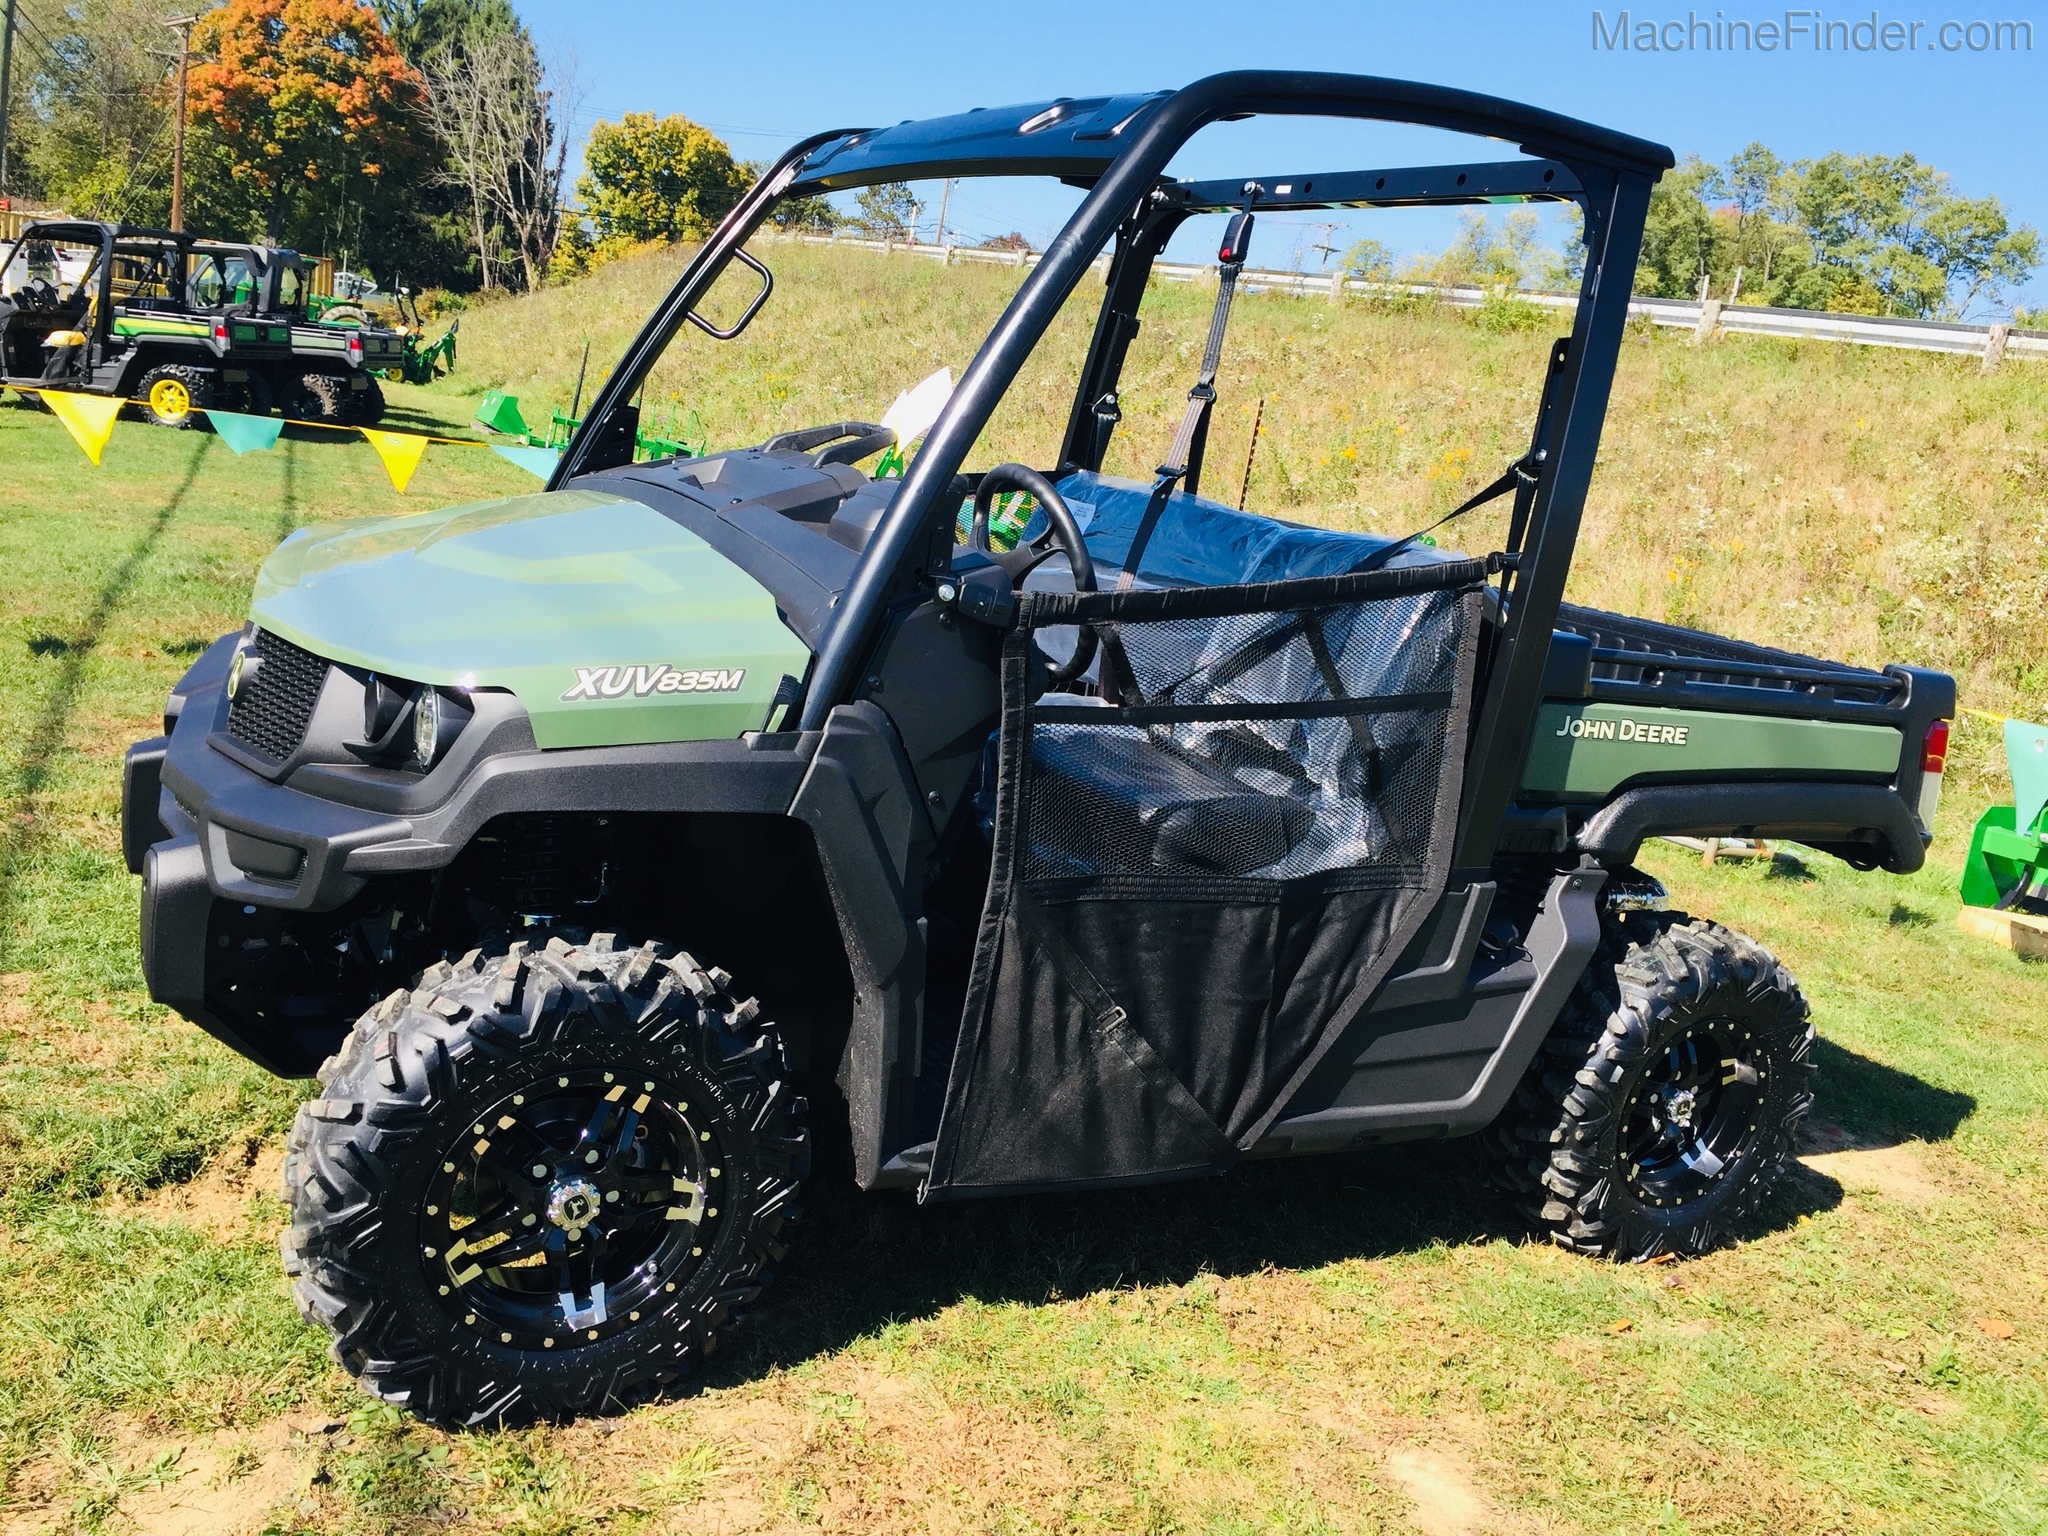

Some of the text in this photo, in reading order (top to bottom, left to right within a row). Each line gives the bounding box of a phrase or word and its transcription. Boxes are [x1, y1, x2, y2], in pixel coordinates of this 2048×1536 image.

[560, 664, 746, 701] XUV835M
[1556, 715, 1689, 745] JOHN DEERE
